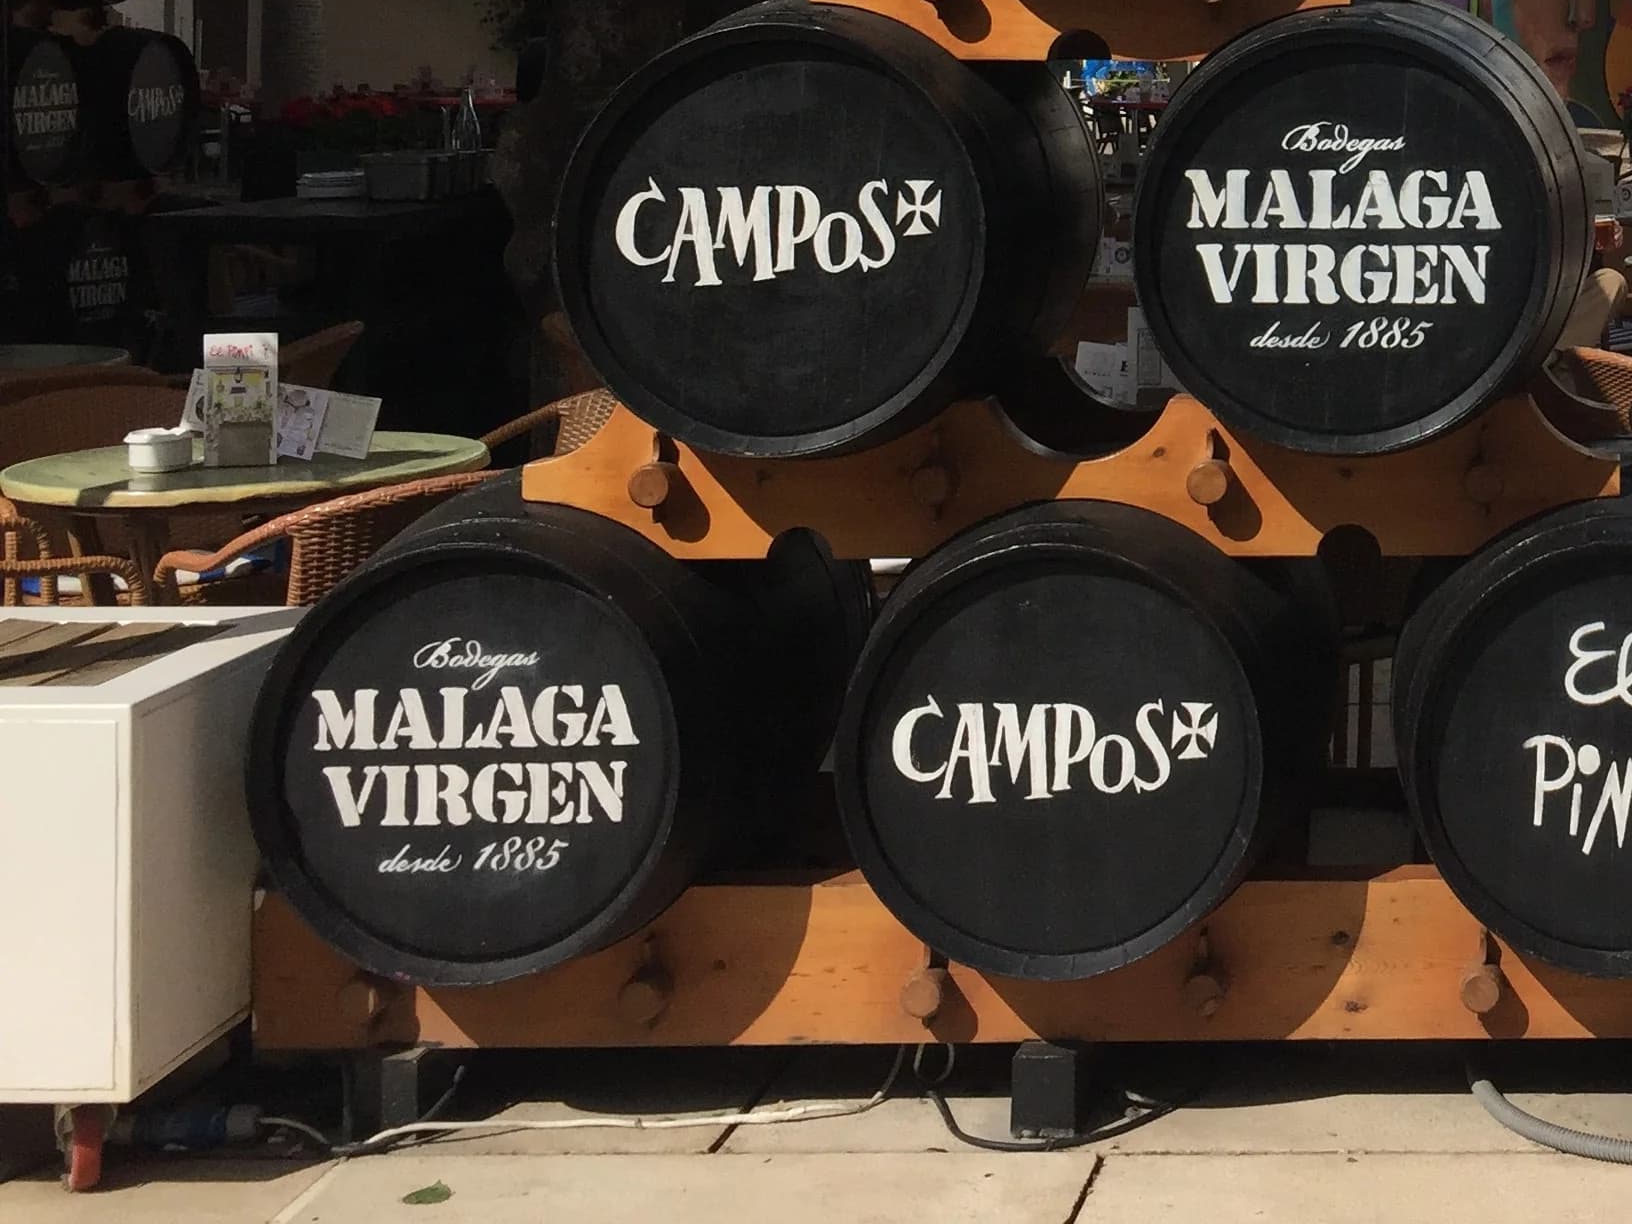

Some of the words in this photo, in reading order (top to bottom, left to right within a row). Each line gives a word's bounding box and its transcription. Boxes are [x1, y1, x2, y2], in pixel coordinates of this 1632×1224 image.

[13, 82, 80, 106] MALAGA
[15, 109, 78, 136] VIRGEN
[1282, 122, 1406, 175] Bodegas
[1184, 168, 1502, 230] MALAGA
[1196, 243, 1491, 305] VIRGEN
[1249, 321, 1328, 349] desde
[1339, 317, 1434, 349] 1885
[413, 637, 540, 693] Bodegas
[312, 684, 641, 751] MALAGA
[322, 761, 628, 827] VIRGEN
[379, 843, 462, 873] desde
[474, 836, 570, 872] 1885
